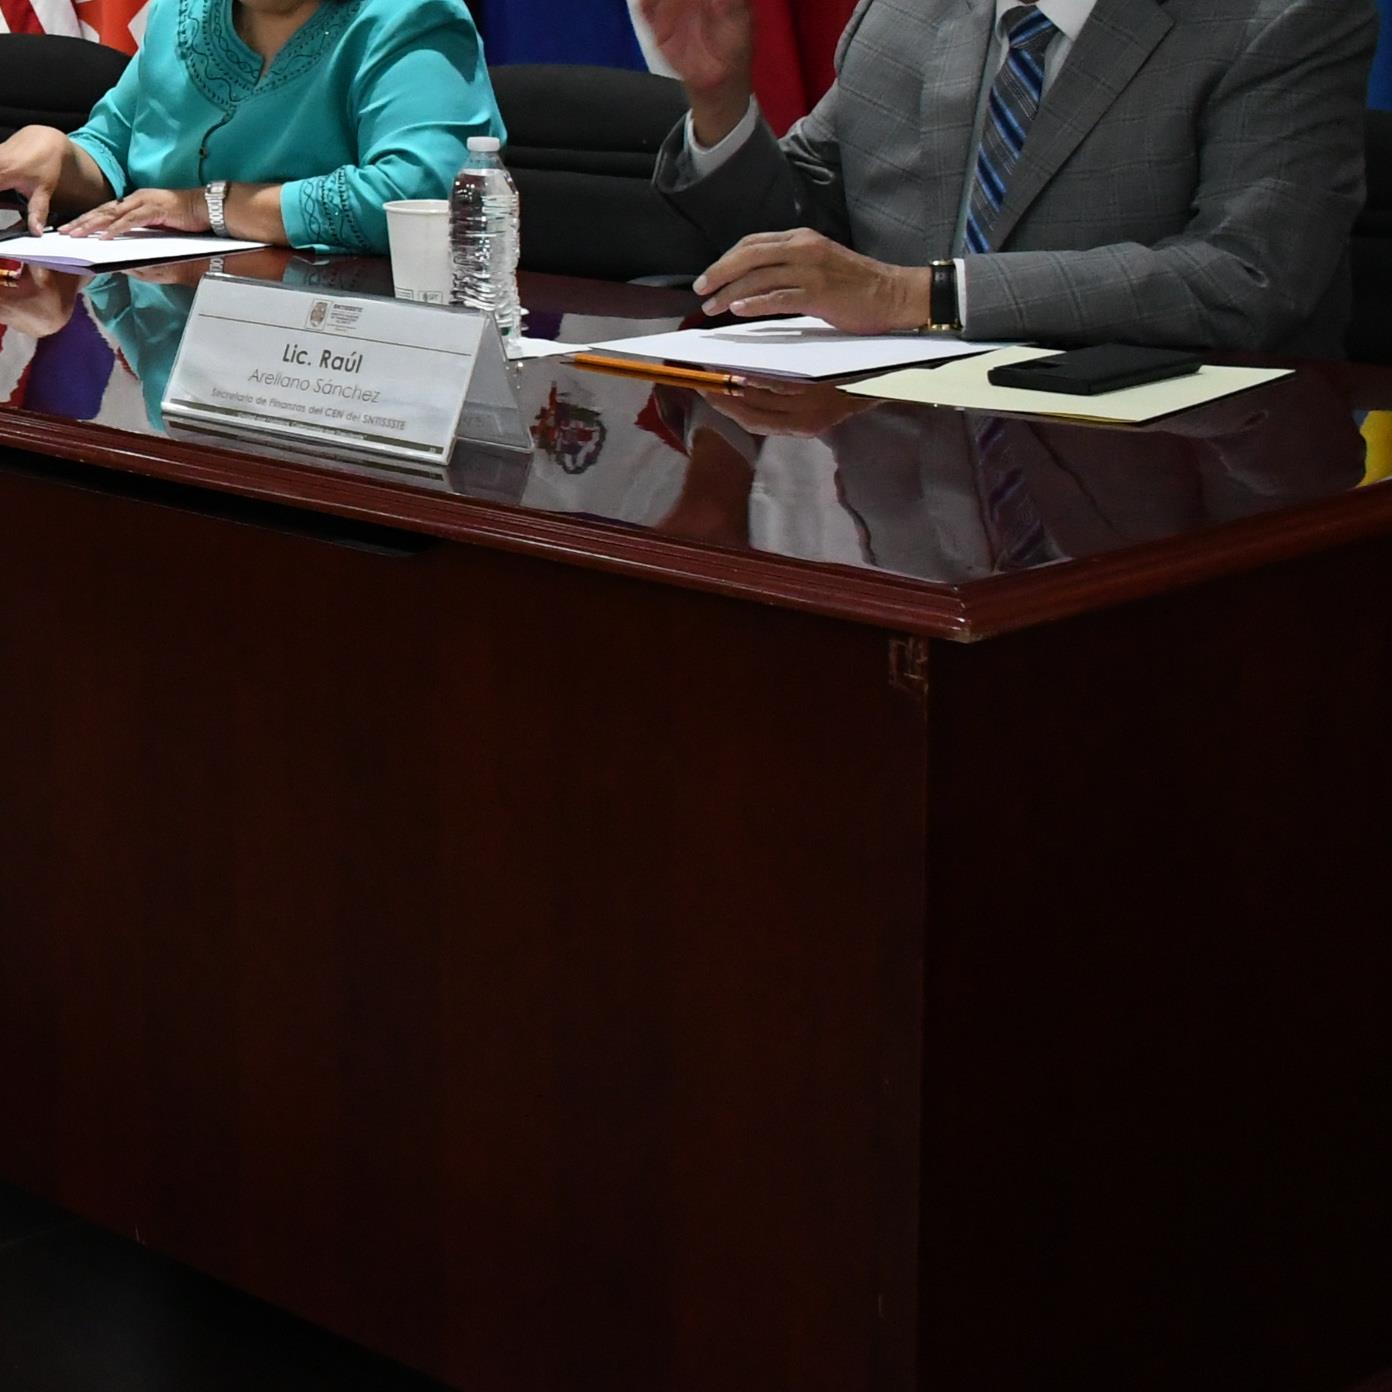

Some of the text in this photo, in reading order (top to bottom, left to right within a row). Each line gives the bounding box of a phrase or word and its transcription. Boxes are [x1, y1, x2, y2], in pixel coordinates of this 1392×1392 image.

[282, 343, 364, 374] Lic. Raúl
[248, 368, 381, 404] Arellano Sánchez
[256, 396, 267, 405] de
[269, 398, 306, 413] Finanzas
[308, 406, 323, 415] del
[325, 408, 344, 419] CEN
[346, 411, 361, 422] del
